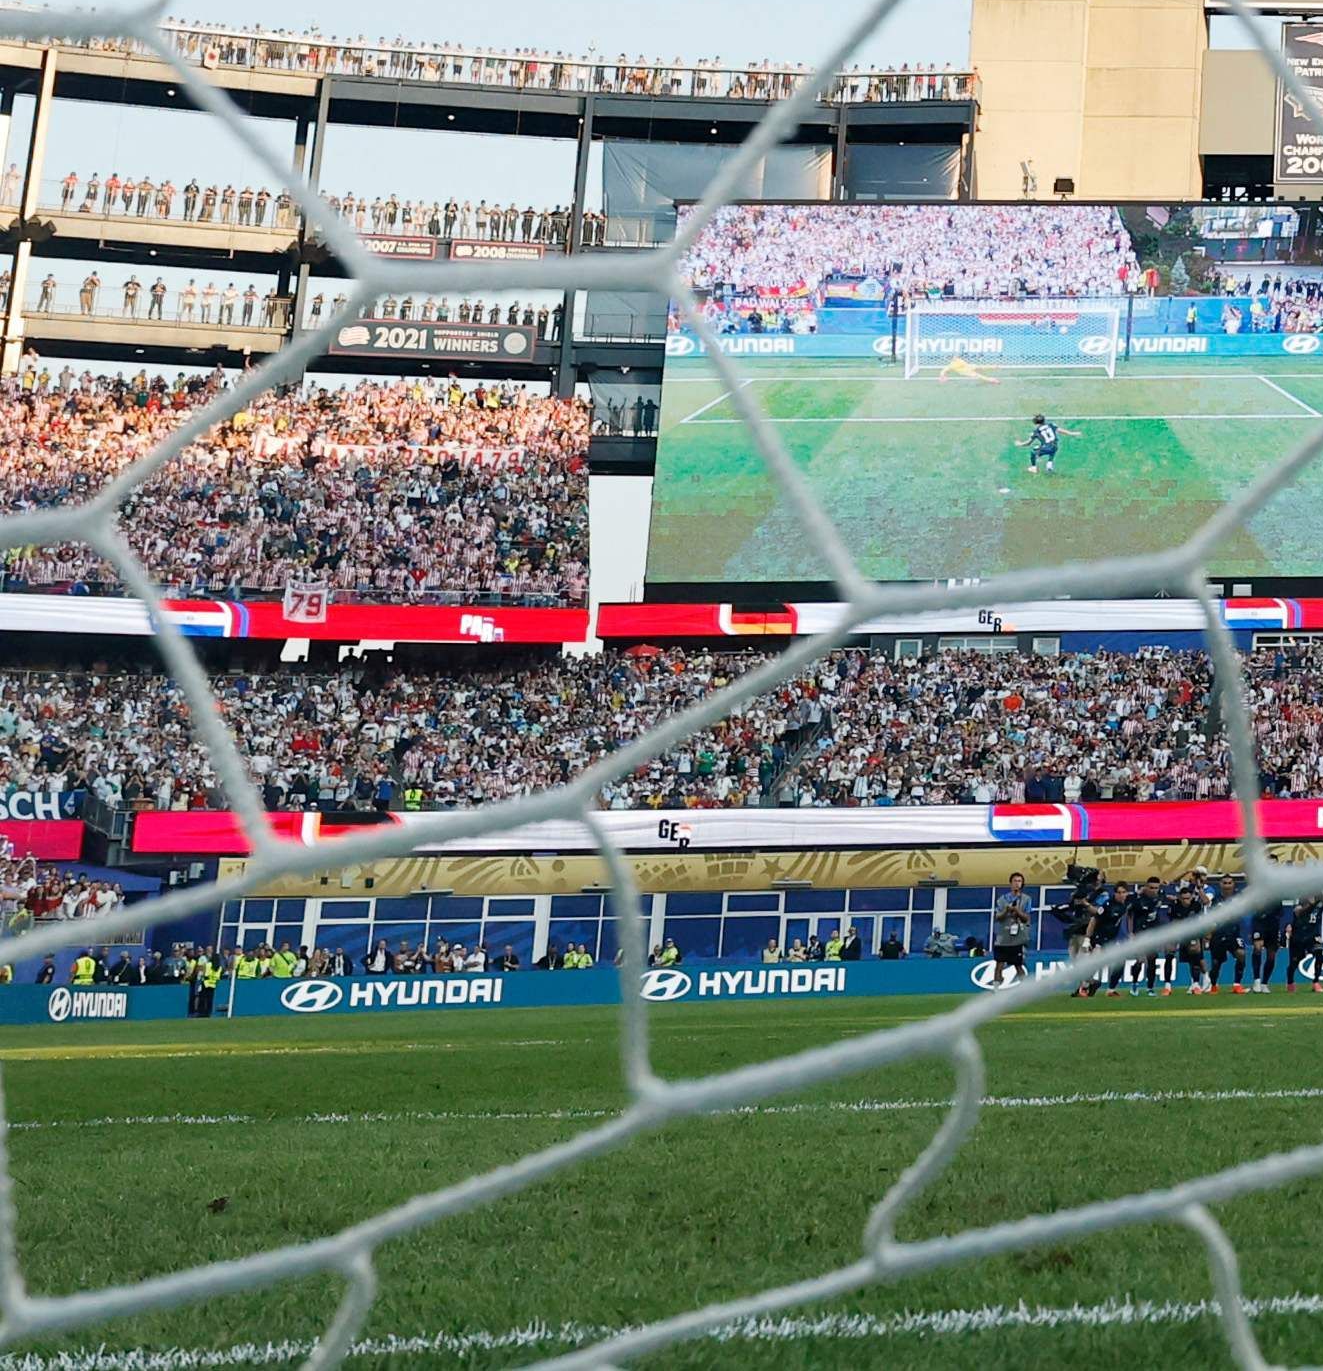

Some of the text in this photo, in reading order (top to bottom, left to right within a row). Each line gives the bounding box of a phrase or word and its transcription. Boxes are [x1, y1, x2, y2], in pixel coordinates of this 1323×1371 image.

[1287, 58, 1308, 66] NEW
[373, 327, 498, 353] 2021 WINNERS
[289, 591, 322, 617] 79
[349, 977, 503, 1007] HYUNDAI
[699, 967, 846, 996] HYUNDAI
[73, 991, 127, 1018] HYUNDAI
